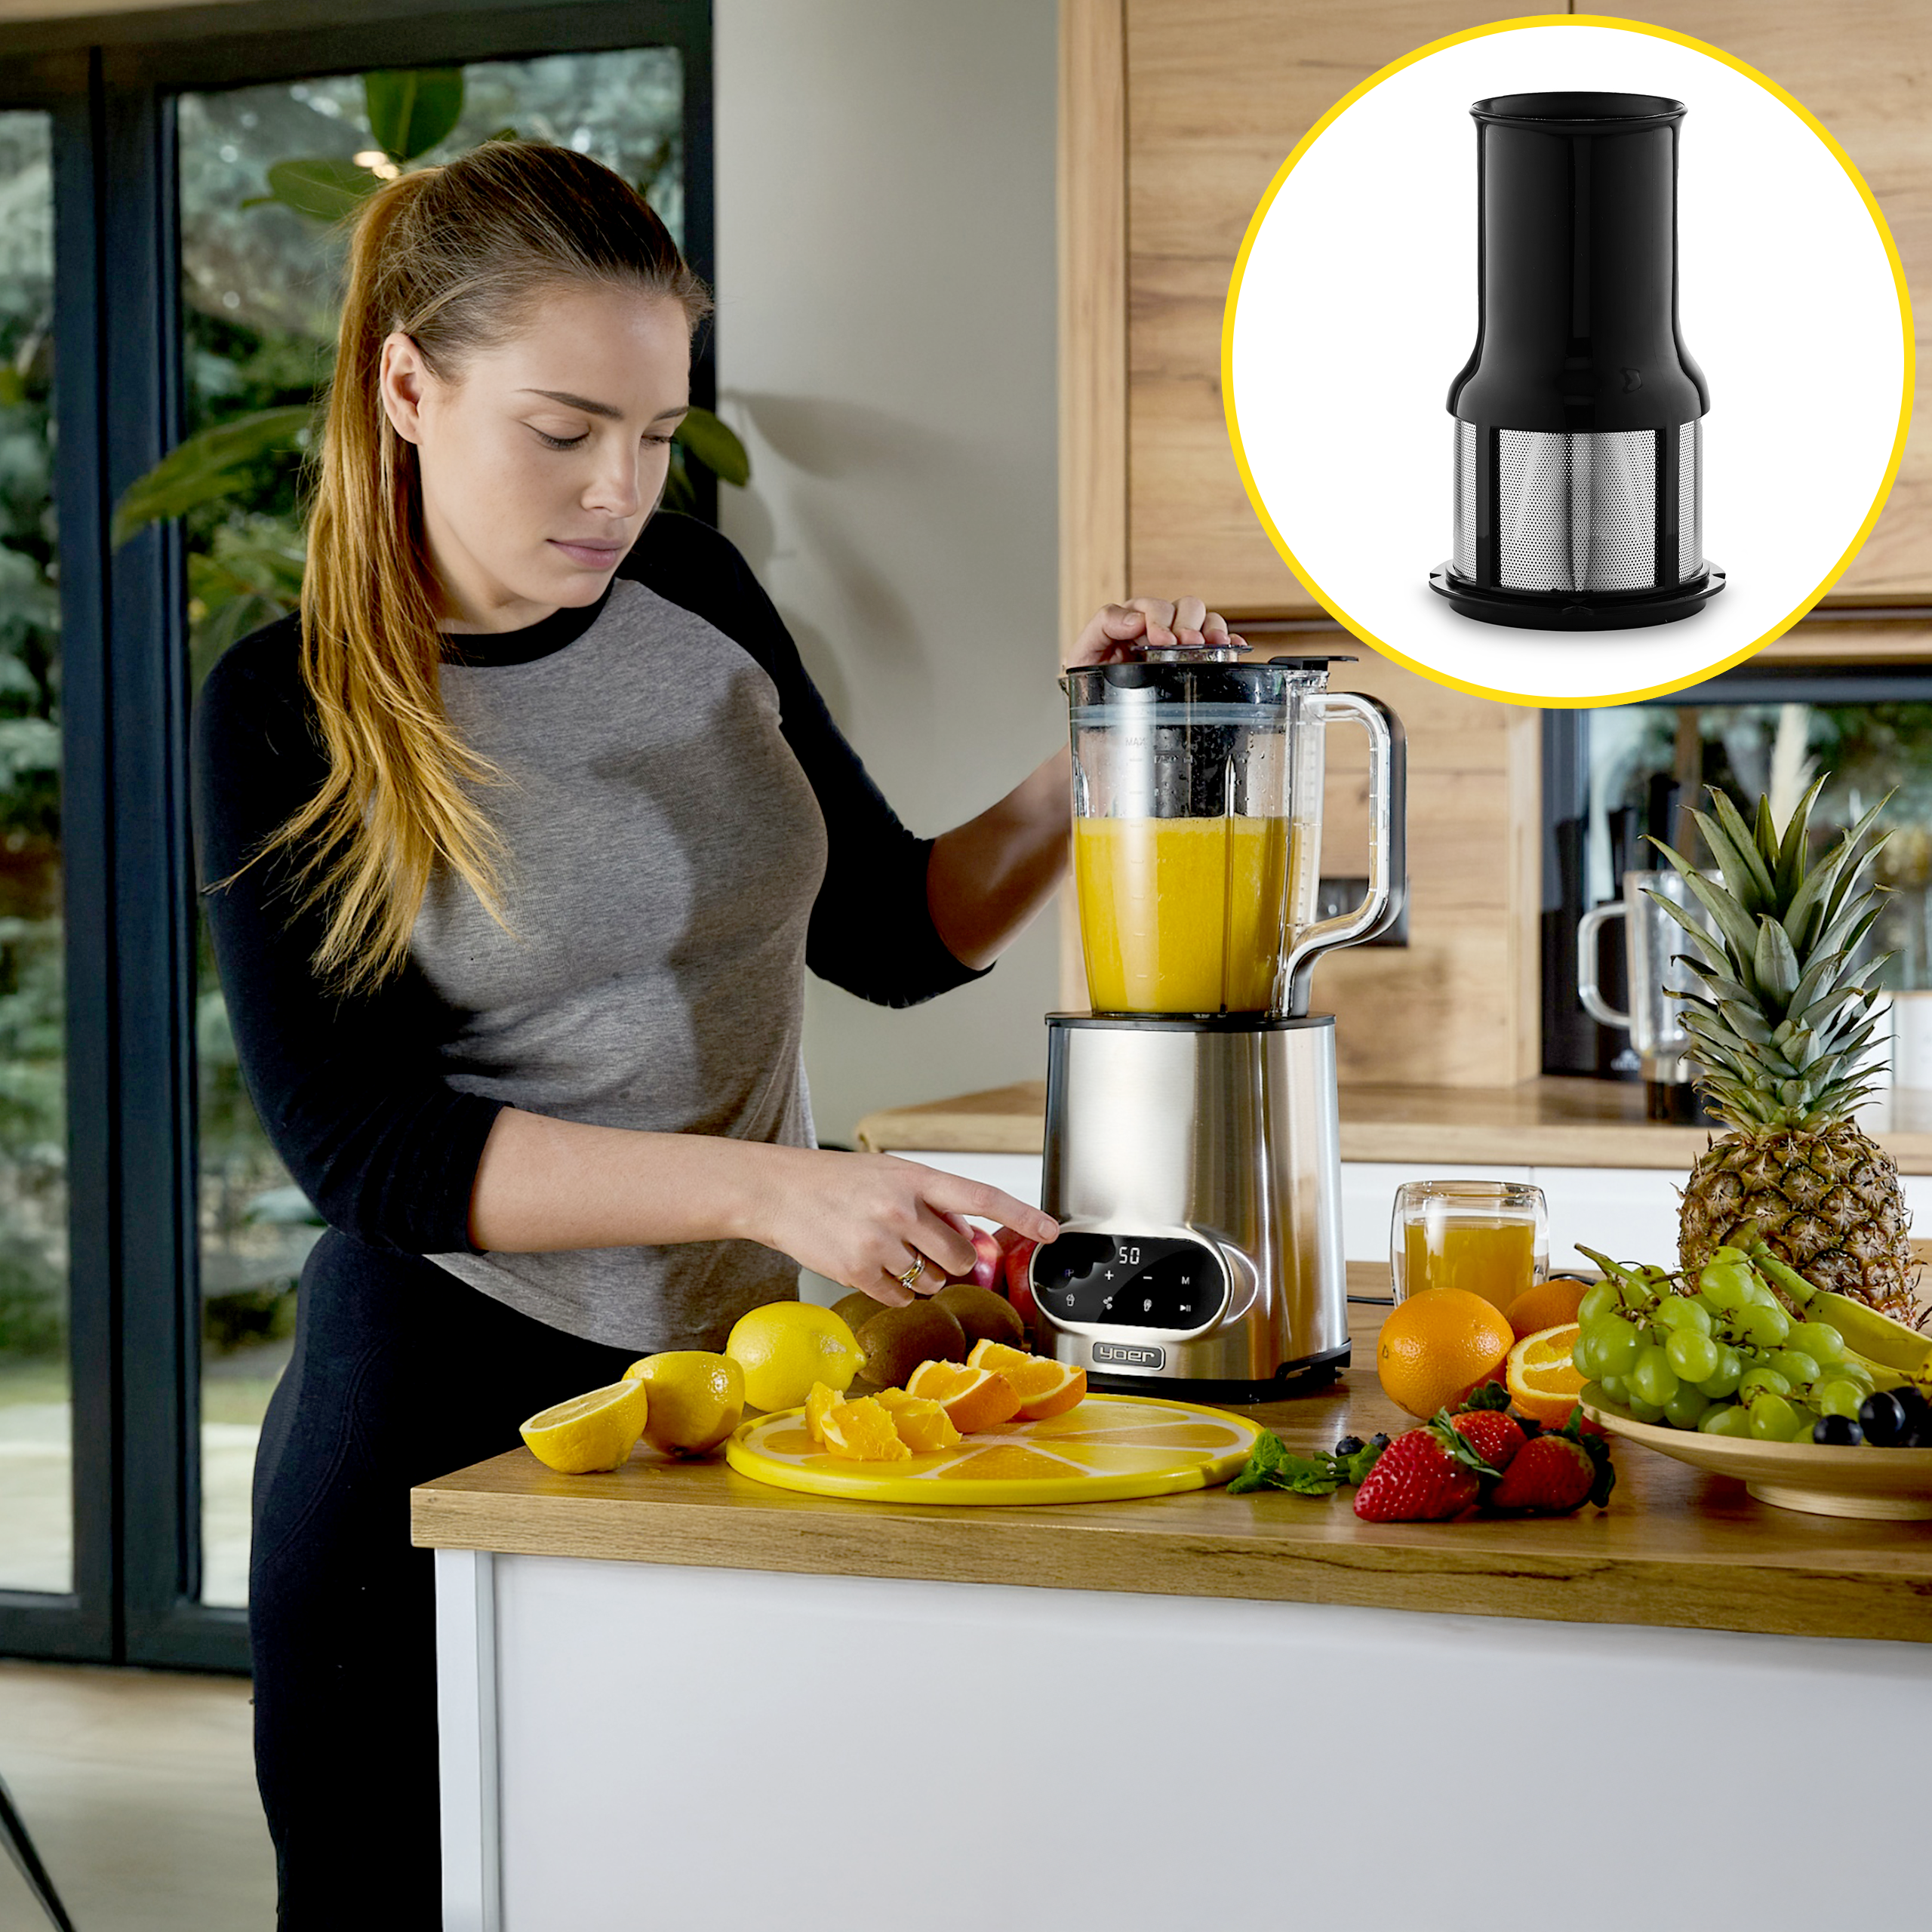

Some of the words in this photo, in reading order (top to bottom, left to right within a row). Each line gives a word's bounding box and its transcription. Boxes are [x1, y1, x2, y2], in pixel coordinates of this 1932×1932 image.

[1125, 737, 1146, 746] MAX
[1119, 1246, 1140, 1264] 50
[1181, 1276, 1190, 1284] M
